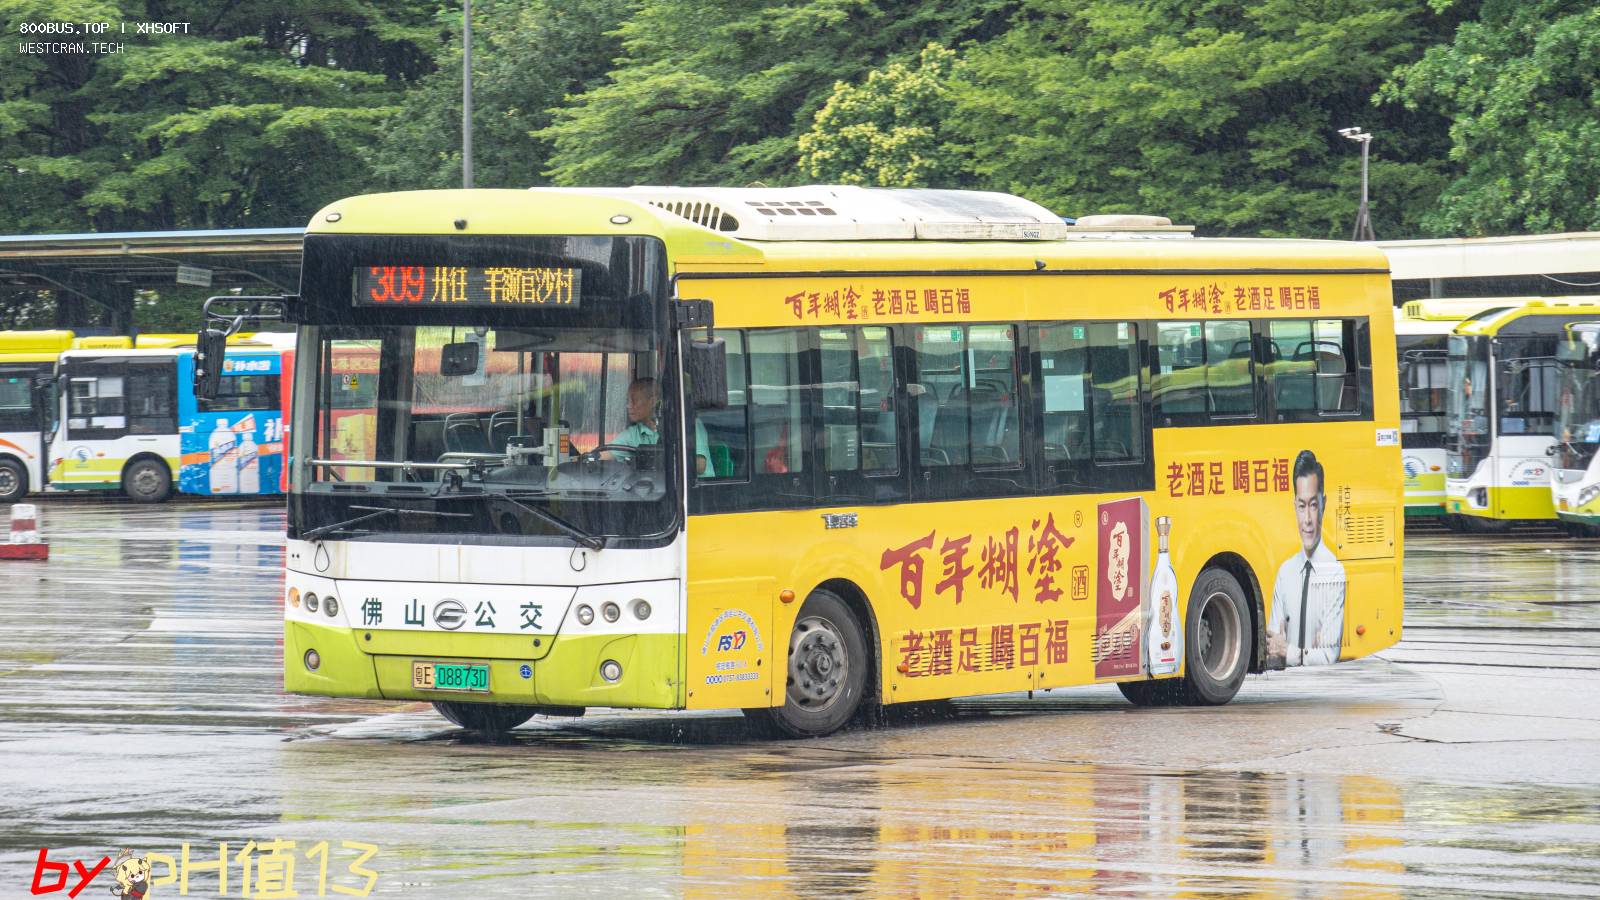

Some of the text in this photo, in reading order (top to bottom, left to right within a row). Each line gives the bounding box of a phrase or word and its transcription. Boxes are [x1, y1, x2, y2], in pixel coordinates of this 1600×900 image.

[370, 266, 425, 302] 309
[1233, 286, 1276, 311] 老酒足
[1279, 286, 1321, 310] 喝百福
[871, 289, 920, 316] 老酒足
[924, 288, 971, 314] 喝百福
[1166, 457, 1290, 497] 老酒足 喝百福
[361, 597, 543, 630] 佛山公交
[900, 619, 1069, 677] 老酒足 喝百福
